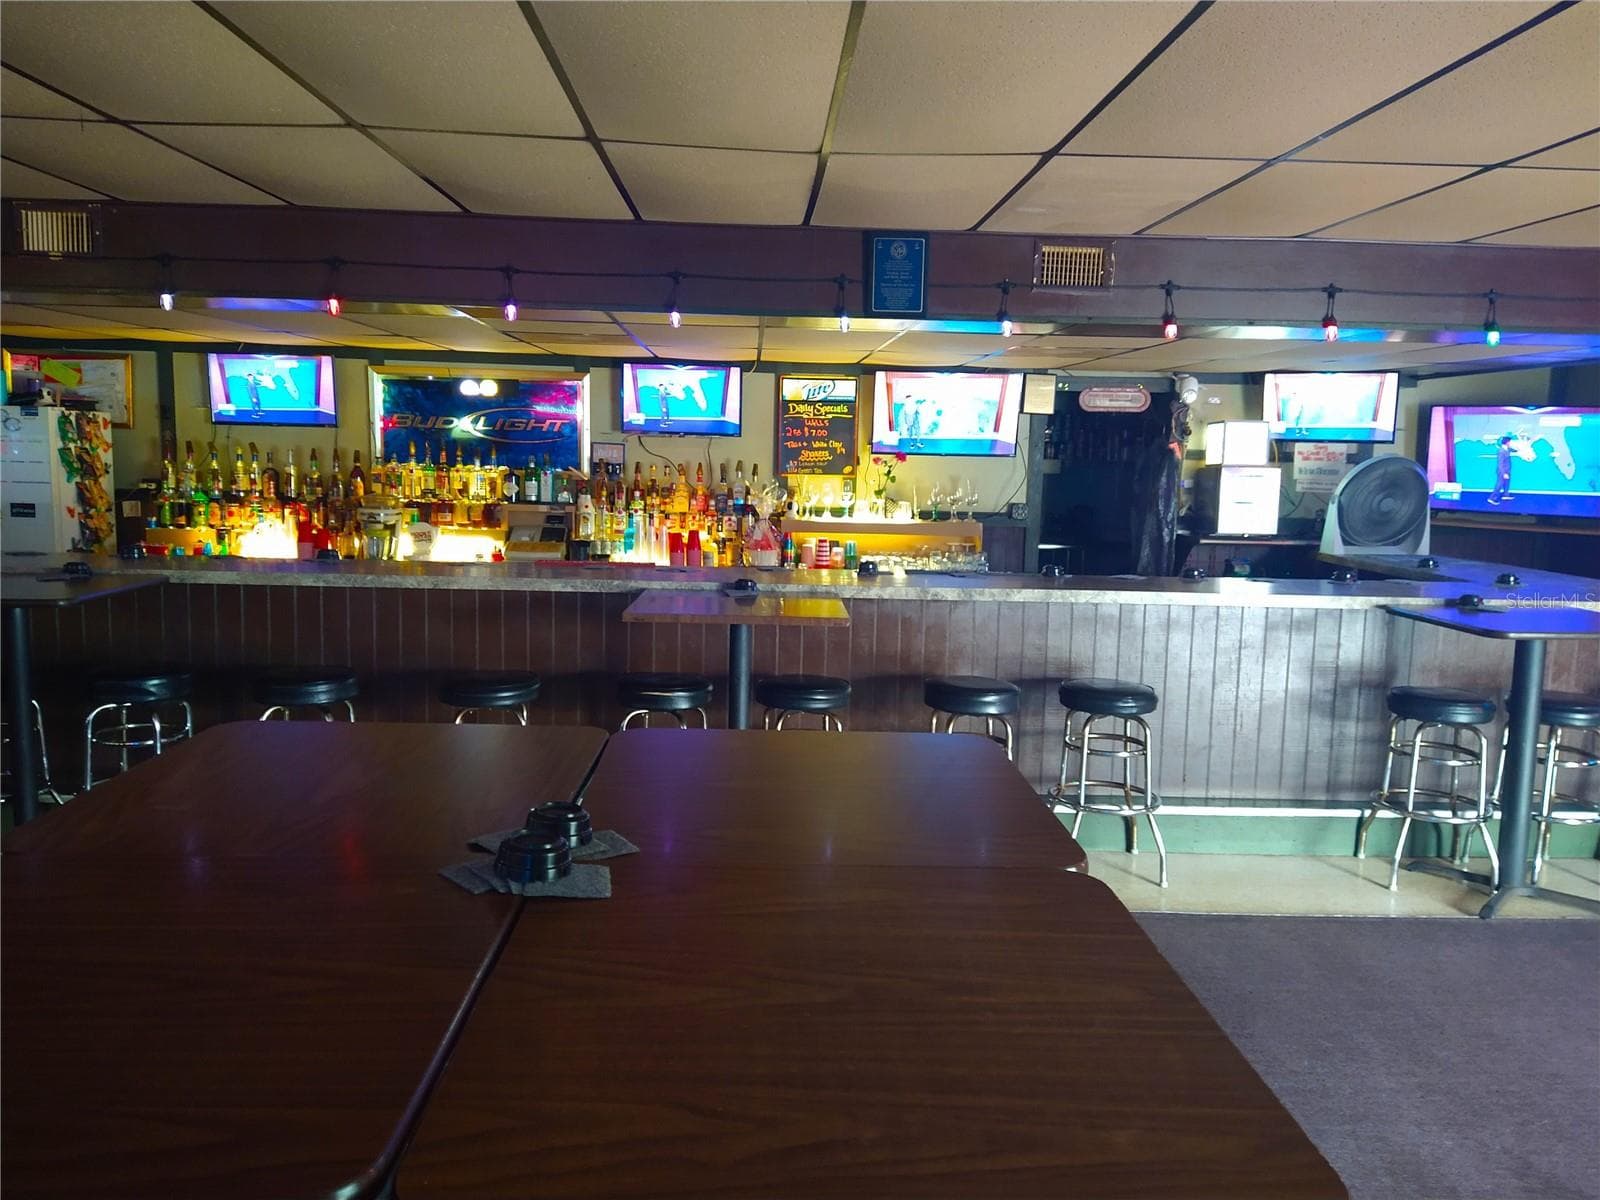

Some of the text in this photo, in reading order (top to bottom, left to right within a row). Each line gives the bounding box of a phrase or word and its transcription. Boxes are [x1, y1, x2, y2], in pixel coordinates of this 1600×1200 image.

[788, 403, 849, 417] Daily Specials
[395, 413, 570, 432] BUD LIGHT
